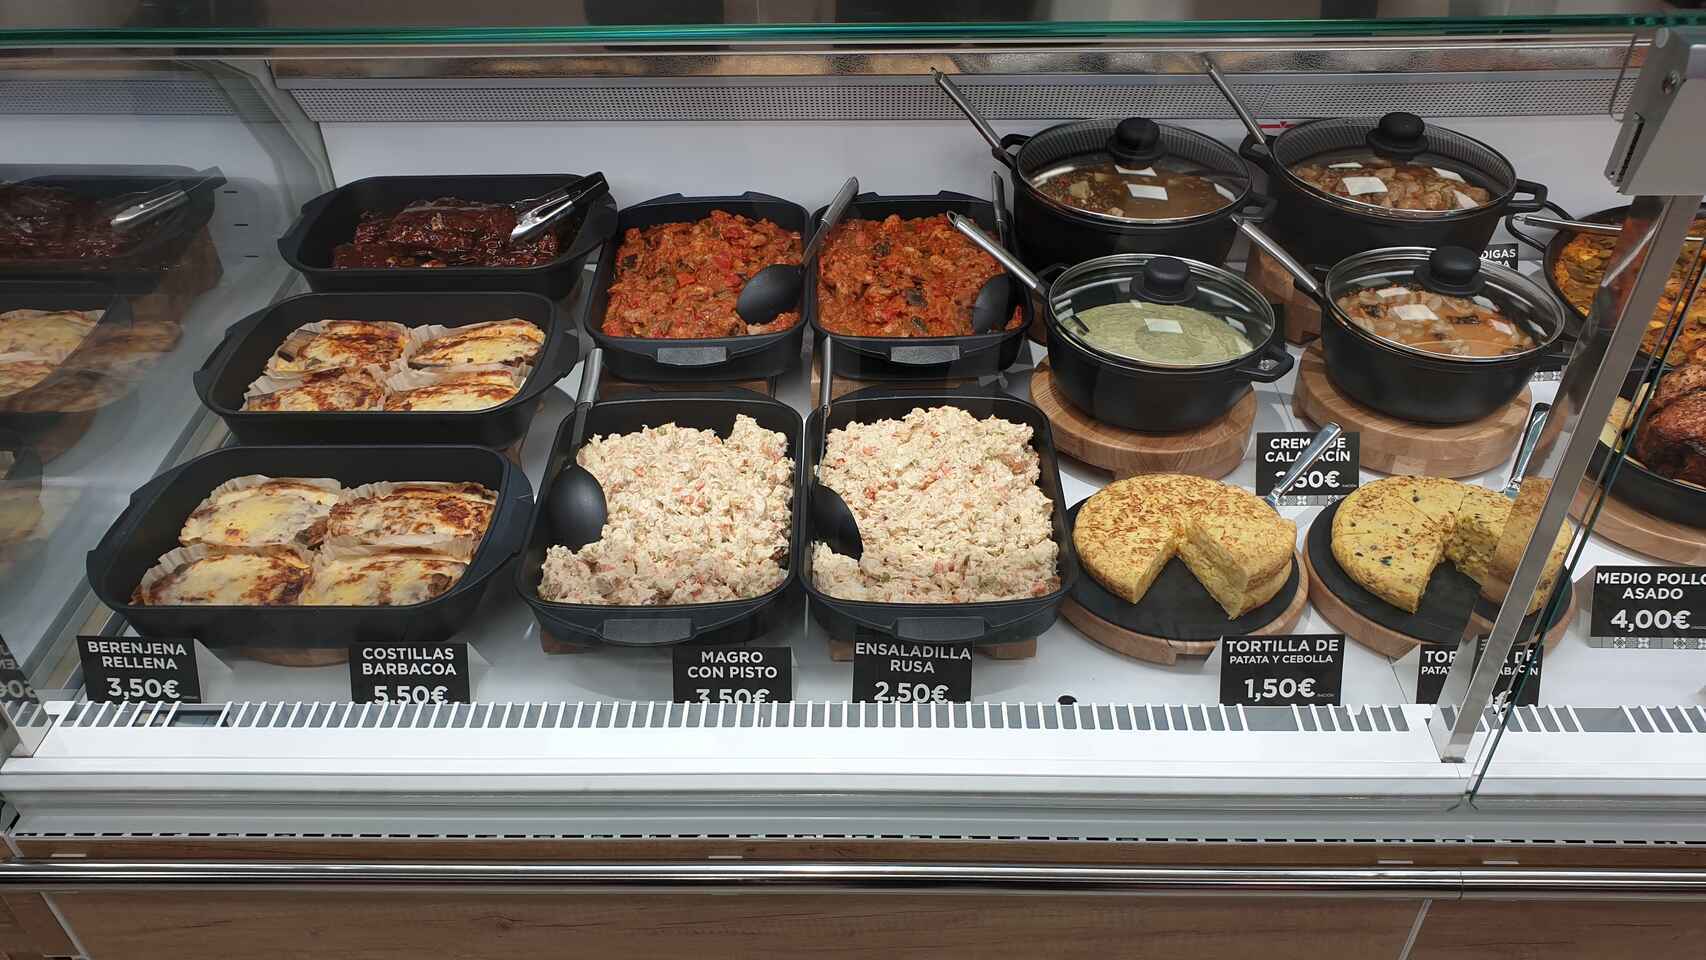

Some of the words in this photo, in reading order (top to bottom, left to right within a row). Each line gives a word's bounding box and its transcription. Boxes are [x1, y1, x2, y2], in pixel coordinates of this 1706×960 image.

[1480, 248, 1516, 259] DIGAS
[1270, 438, 1311, 449] CREM
[1596, 572, 1652, 585] MEDIO
[1622, 587, 1684, 600] ASADO
[1610, 609, 1692, 633] 4,00€
[87, 641, 187, 656] BERENJENA
[855, 642, 972, 660] ENSALADILLA
[1226, 640, 1310, 653] TORTILLA
[1315, 639, 1339, 652] DE
[362, 648, 455, 660] COSTILLAS
[701, 651, 764, 663] MAGRO
[1229, 655, 1270, 664] PATATA
[1272, 655, 1280, 664] Y
[1282, 654, 1334, 664] CEBOLLA
[102, 656, 178, 670] RELLENA
[362, 663, 457, 675] BARBACOA
[890, 660, 935, 673] RUSA
[687, 666, 724, 678] CON
[729, 666, 778, 678] PISTO
[106, 677, 181, 700] 3,50€
[874, 681, 949, 704] 2,50€
[1244, 678, 1316, 702] 1,50€
